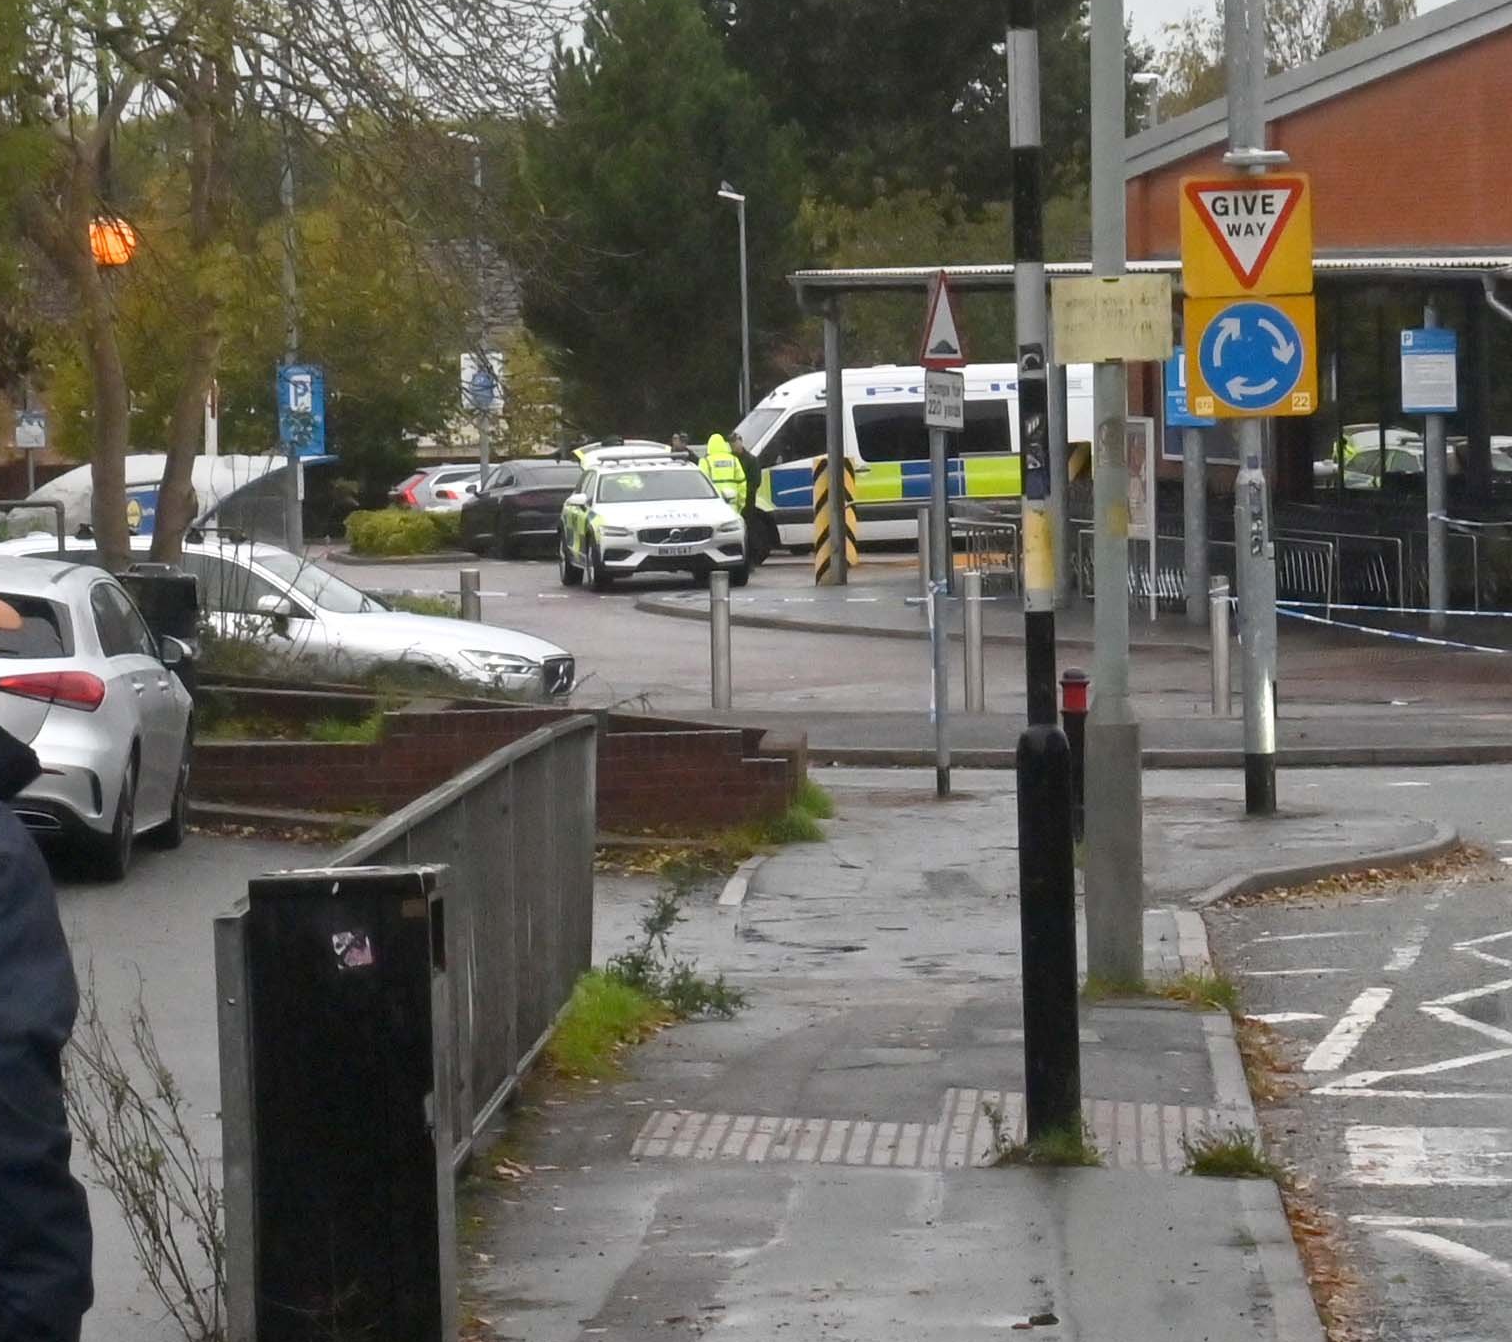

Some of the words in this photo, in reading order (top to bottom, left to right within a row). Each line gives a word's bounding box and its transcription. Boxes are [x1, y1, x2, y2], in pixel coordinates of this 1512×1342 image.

[1211, 194, 1276, 217] GIVE
[1226, 222, 1267, 238] WAY
[1293, 395, 1309, 408] 22
